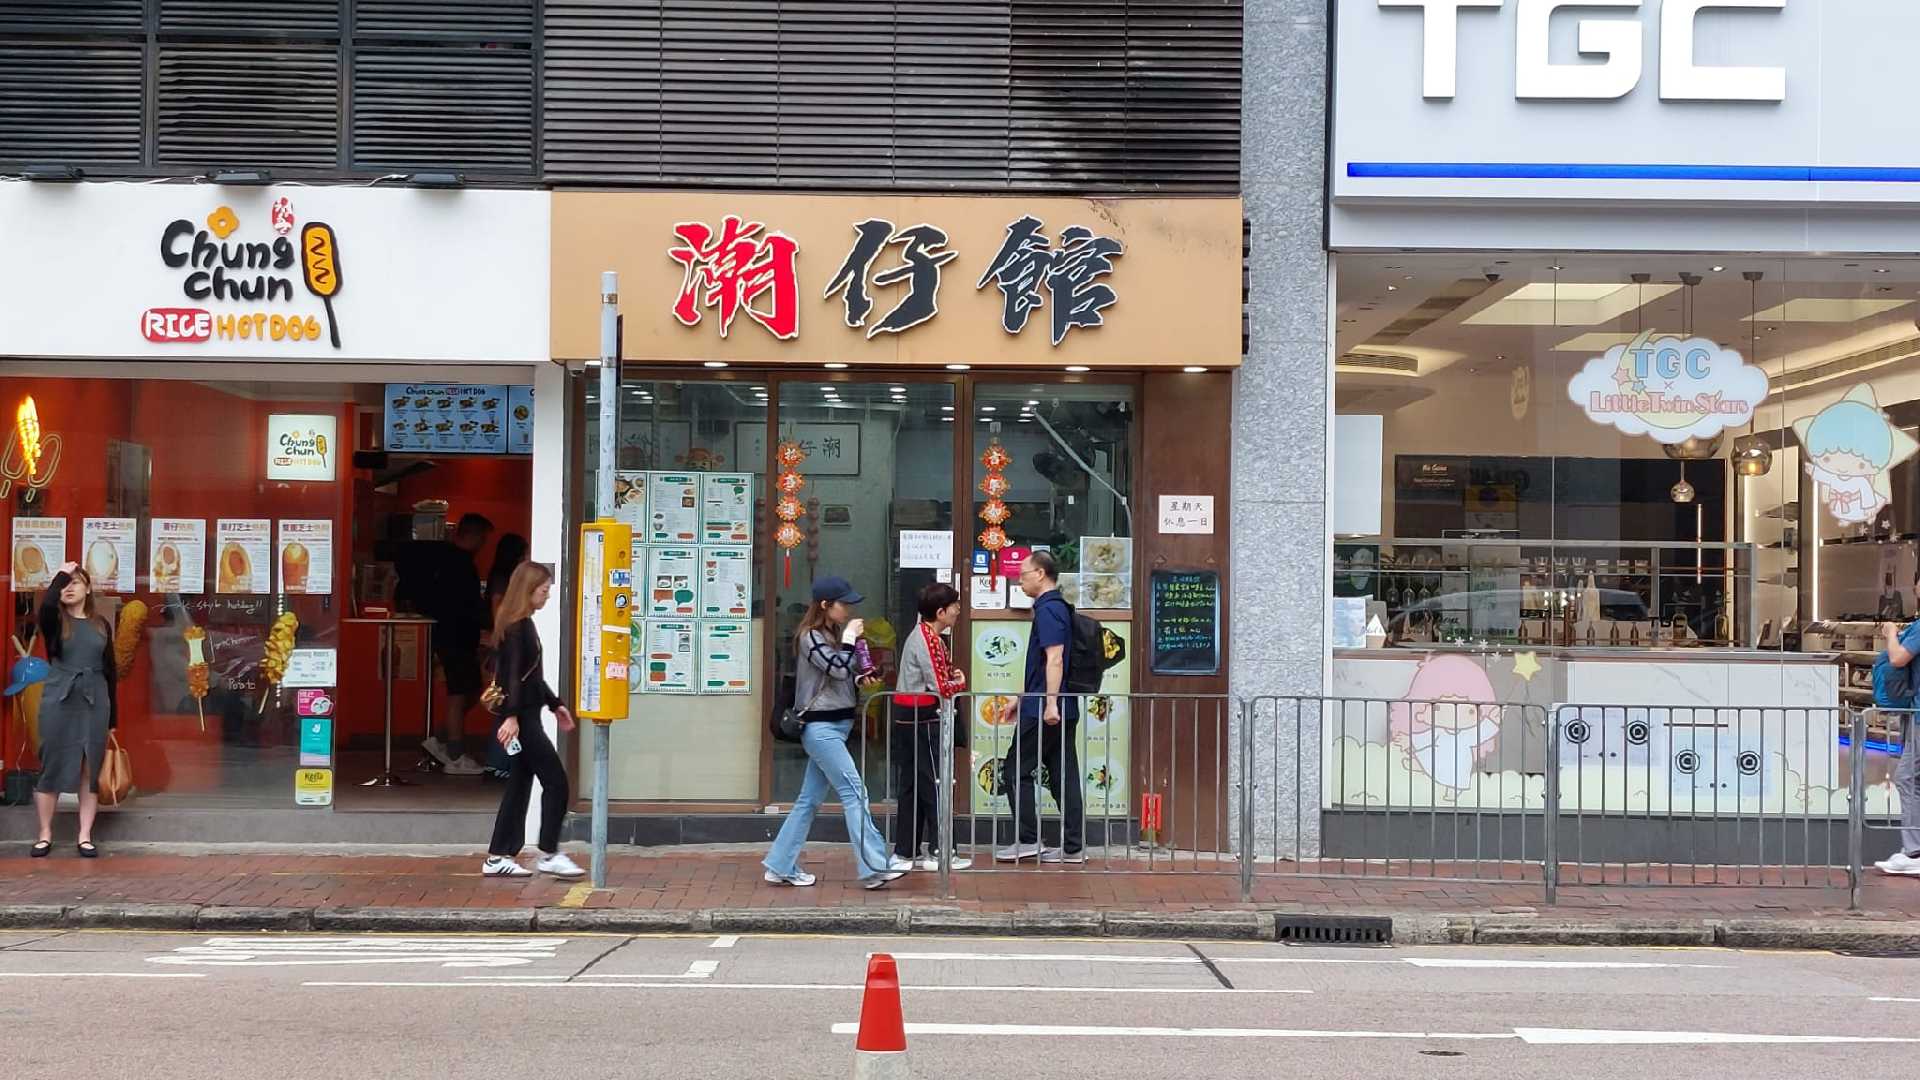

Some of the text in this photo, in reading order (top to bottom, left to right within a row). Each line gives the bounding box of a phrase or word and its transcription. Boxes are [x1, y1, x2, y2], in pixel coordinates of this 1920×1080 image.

[1378, 0, 1786, 101] TGC
[161, 219, 295, 270] Chung
[668, 215, 1123, 346] 潮仔館
[145, 311, 210, 338] RICE
[1631, 348, 1711, 379] TGC
[280, 433, 316, 447] Chung
[1169, 501, 1204, 511] 星期天
[1164, 517, 1208, 528] 休息一日
